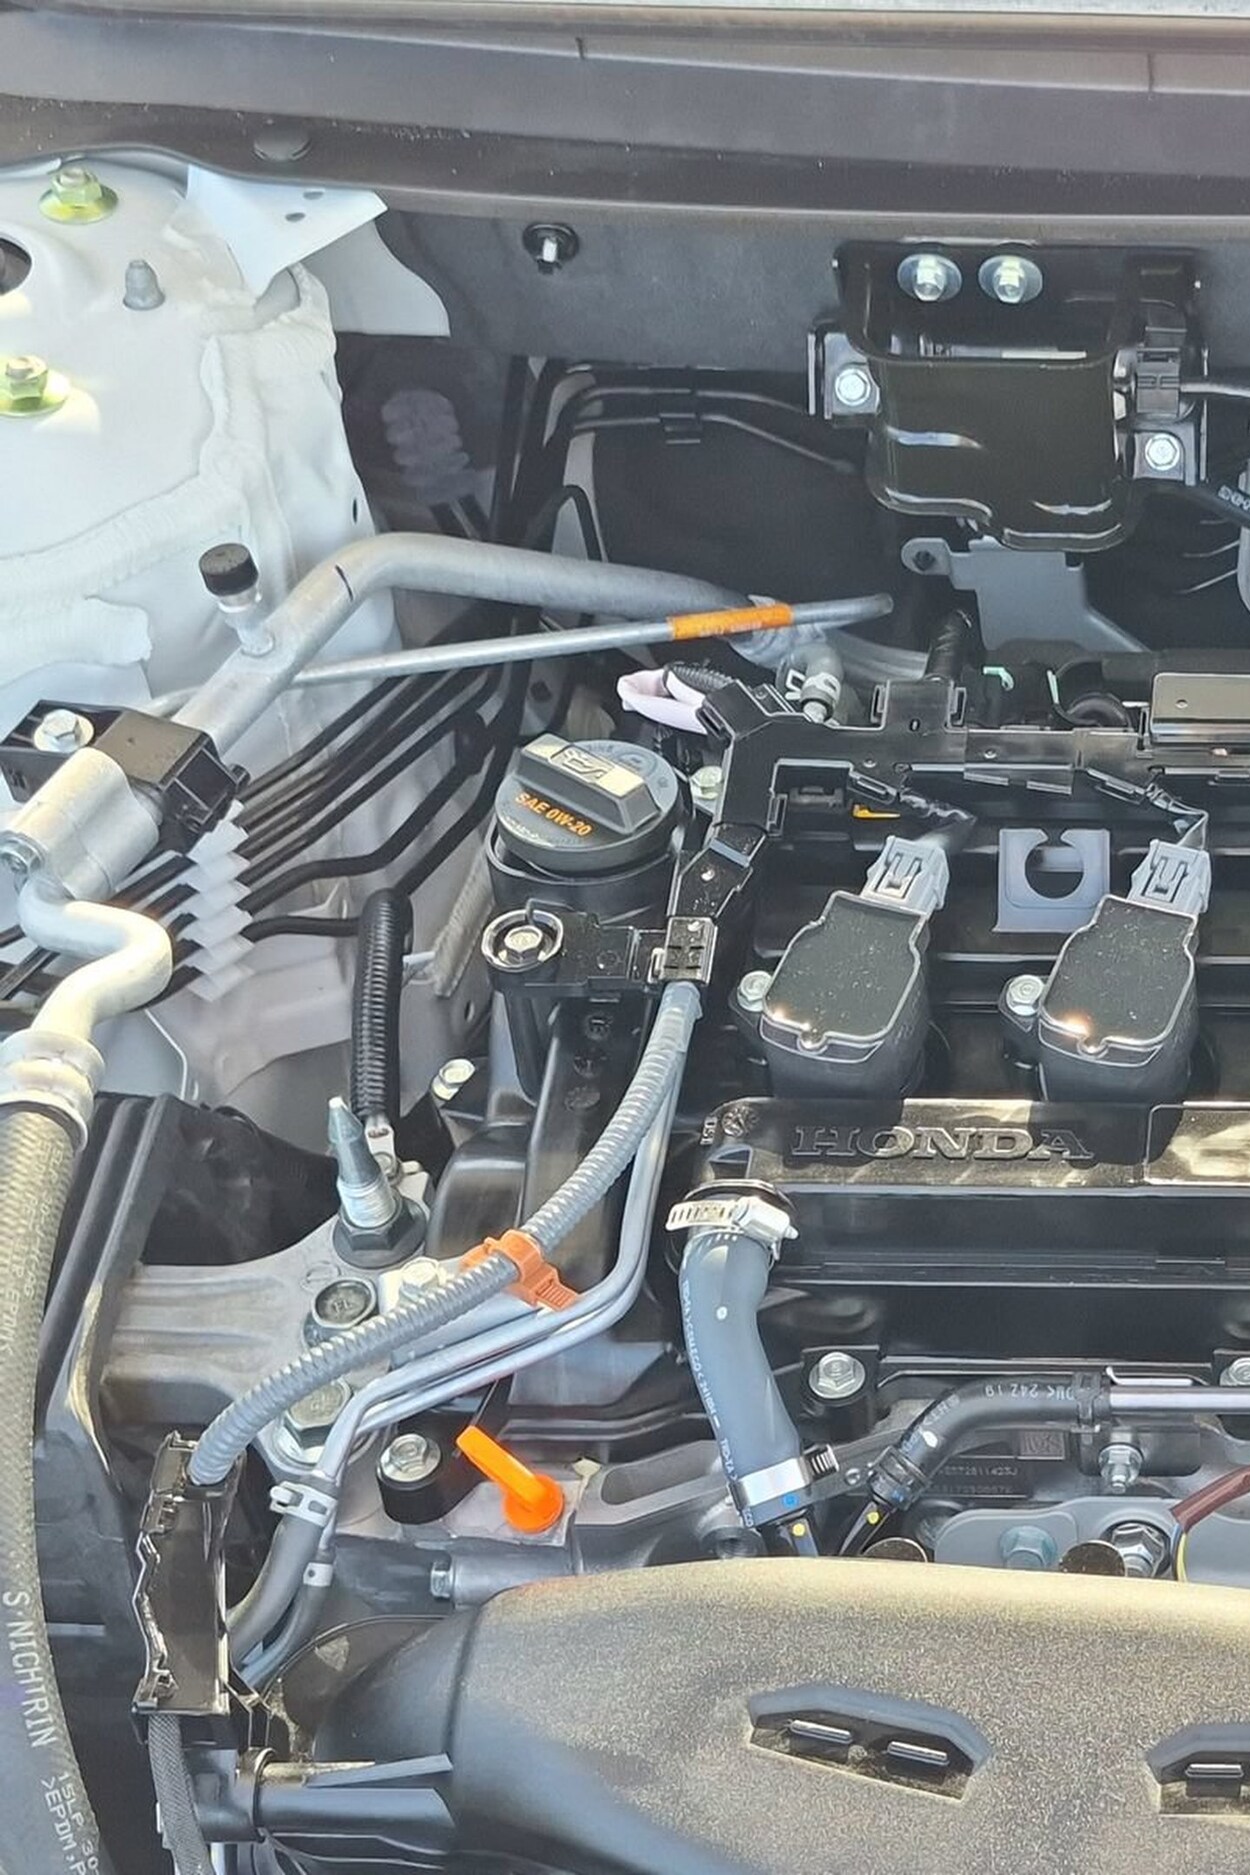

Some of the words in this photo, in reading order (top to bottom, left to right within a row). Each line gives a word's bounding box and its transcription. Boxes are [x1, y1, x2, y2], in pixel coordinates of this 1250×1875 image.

[515, 792, 547, 815] SAE
[546, 806, 593, 837] 0W-20
[791, 1126, 1094, 1161] HONDA
[57, 1771, 85, 1828] 15LP
